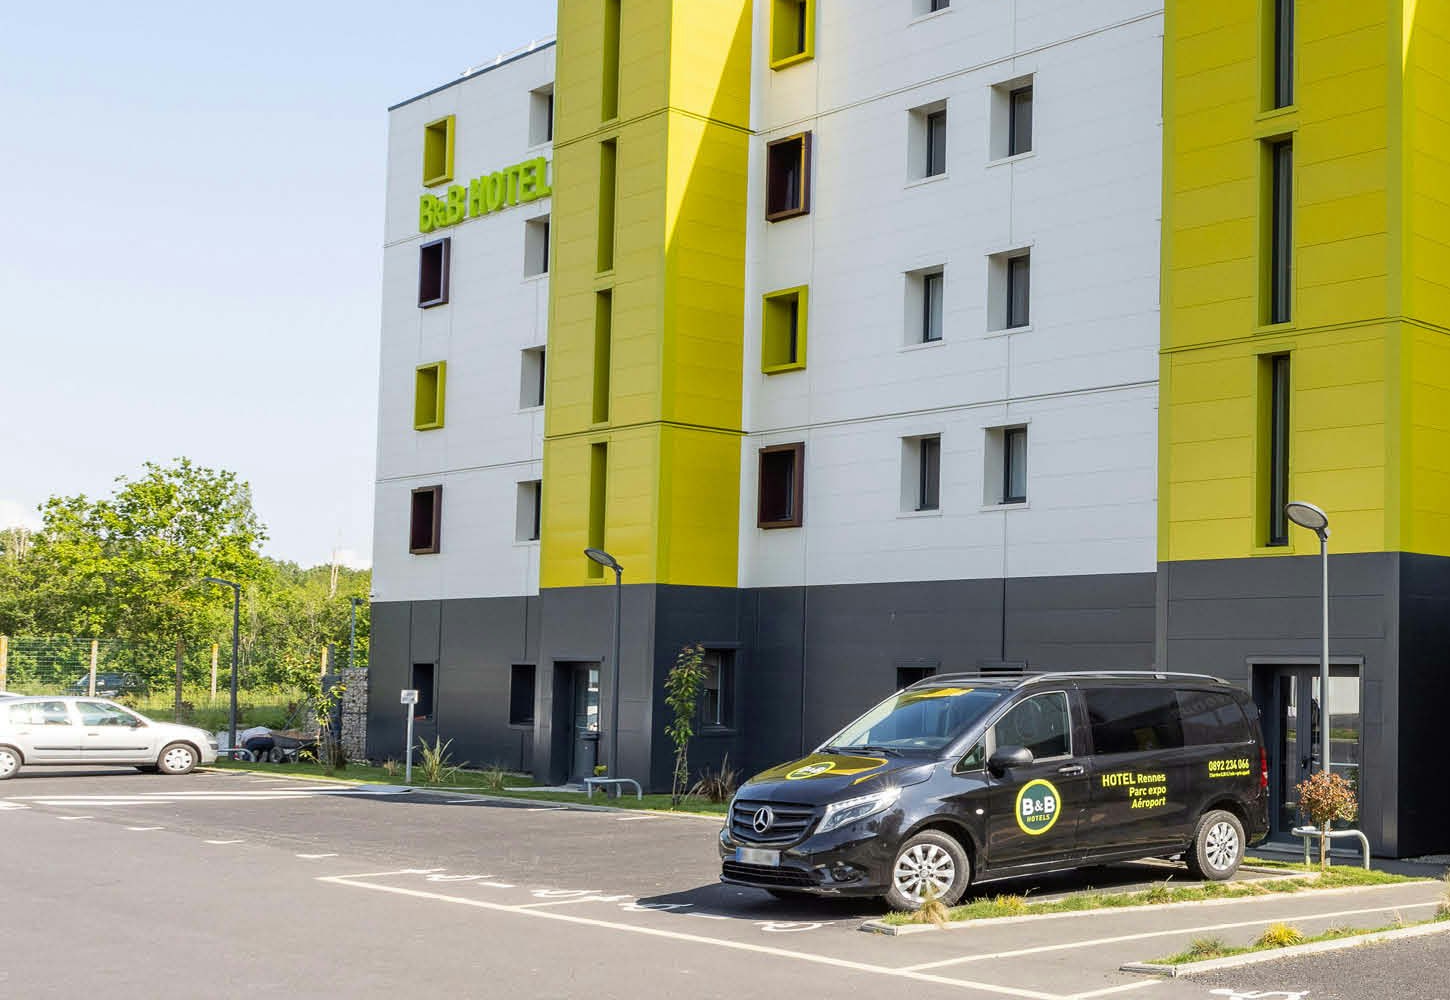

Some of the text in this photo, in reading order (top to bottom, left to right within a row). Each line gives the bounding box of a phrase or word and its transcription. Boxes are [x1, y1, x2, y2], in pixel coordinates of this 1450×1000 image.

[419, 156, 552, 233] B&B HOTEL
[1102, 772, 1166, 787] HOTEL Rennes
[1129, 785, 1167, 797] Parc expo
[1022, 795, 1056, 816] B&B
[1131, 796, 1166, 809] Aéroport
[1026, 814, 1051, 823] HOTELS
